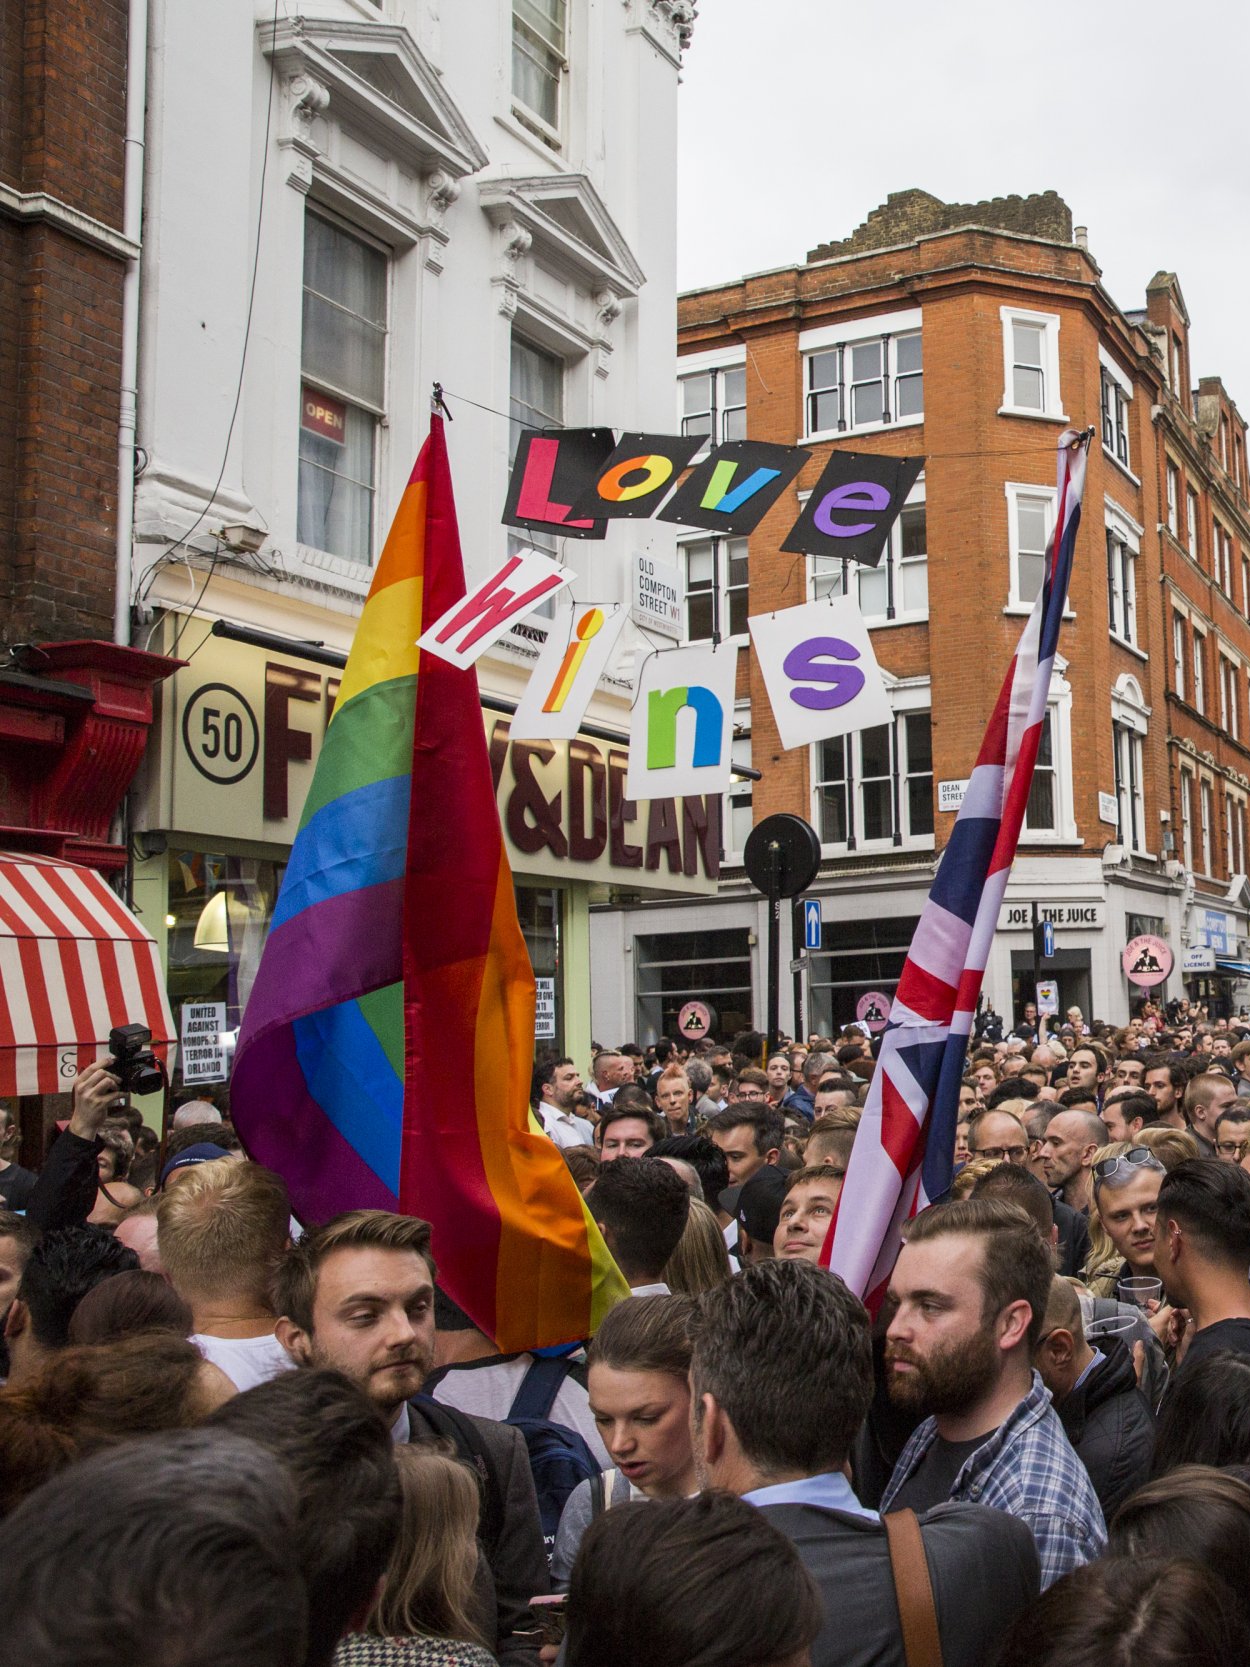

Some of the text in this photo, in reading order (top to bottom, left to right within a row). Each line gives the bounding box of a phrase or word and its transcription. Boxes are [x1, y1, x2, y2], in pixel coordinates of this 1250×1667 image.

[306, 402, 343, 430] OPEN
[639, 557, 654, 576] OLD
[639, 575, 677, 603] COMPTON
[640, 592, 681, 621] STREET W1
[202, 708, 242, 762] 50
[942, 784, 960, 793] DEAN
[942, 792, 966, 801] STREE
[1007, 909, 1028, 923] JOE
[1042, 908, 1064, 922] THE
[1066, 908, 1097, 923] JUICE
[190, 1006, 216, 1019] UNITED
[541, 1002, 546, 1011] TO
[187, 1020, 220, 1033] AGAINST
[185, 1047, 223, 1061] TERROR IN
[187, 1061, 221, 1075] ORLANDO
